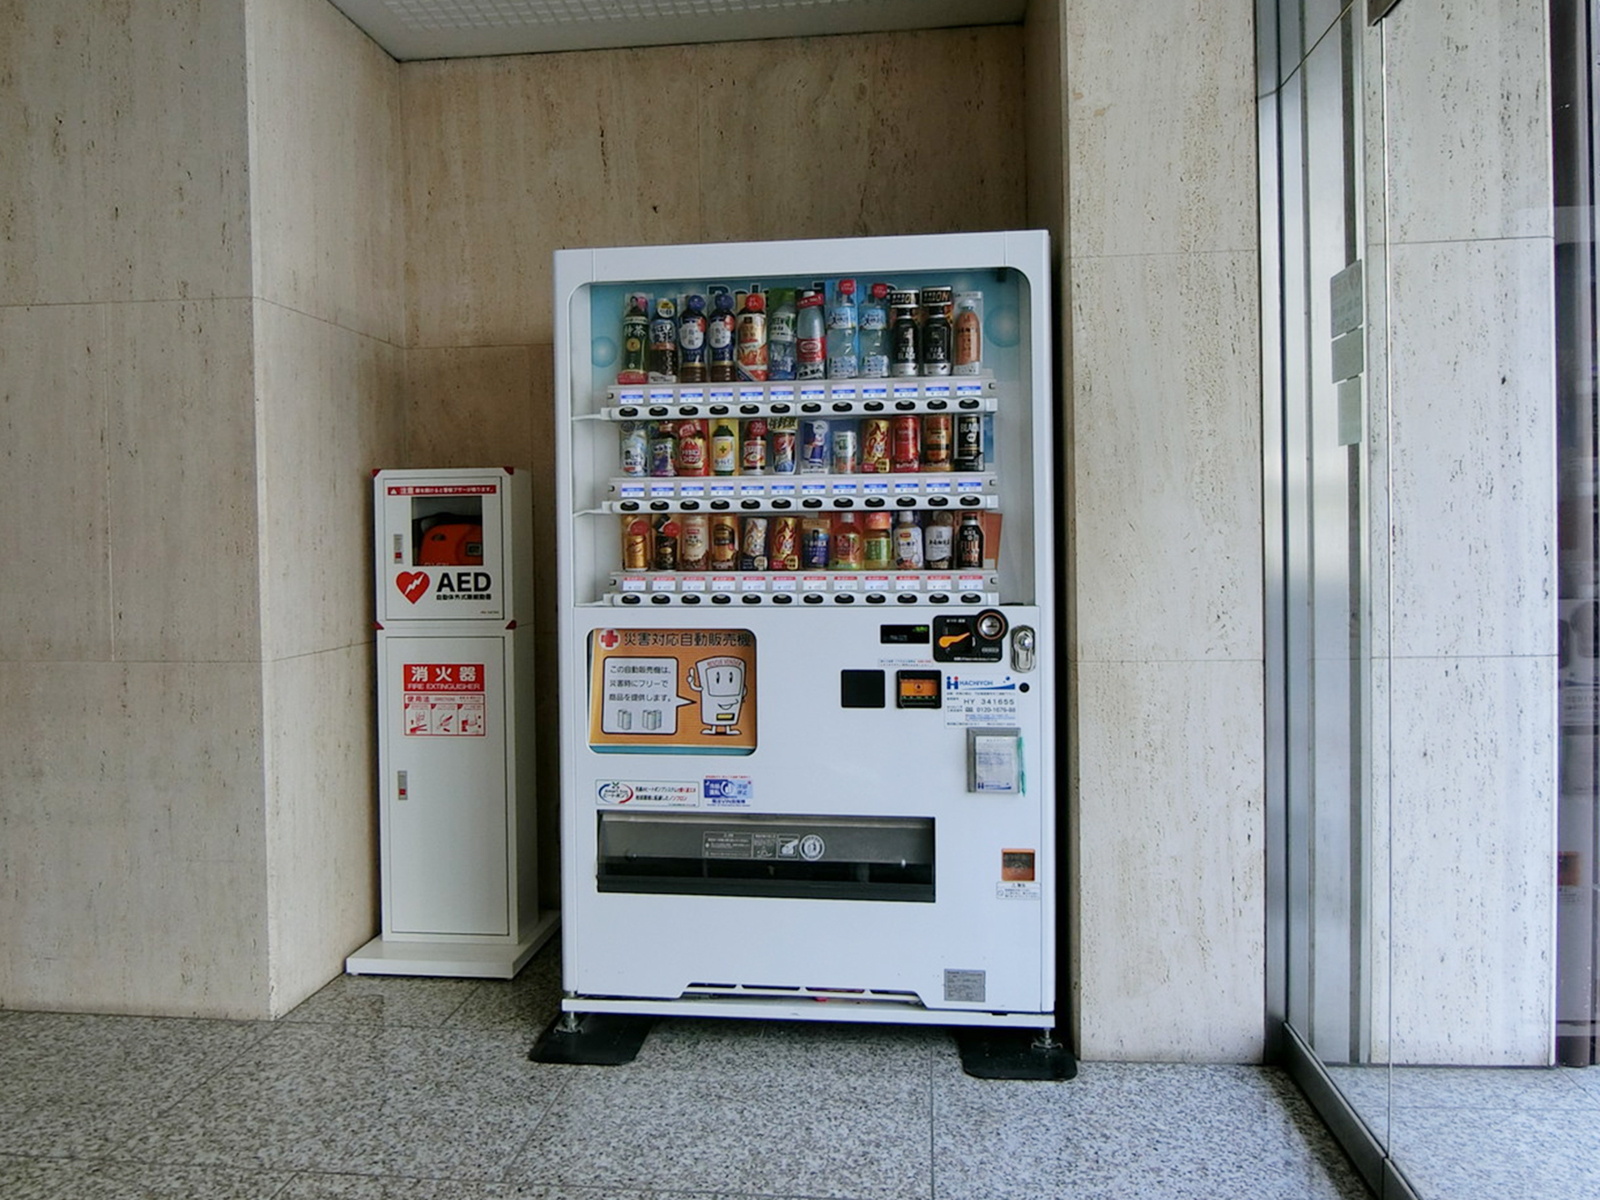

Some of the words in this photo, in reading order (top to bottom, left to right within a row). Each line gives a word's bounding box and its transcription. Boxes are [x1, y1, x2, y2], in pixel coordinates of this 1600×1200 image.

[960, 423, 980, 433] BLACK
[436, 572, 492, 592] AED
[436, 593, 492, 601] 自動体外式除細動器
[624, 631, 752, 647] 災害対応自動販売機
[411, 666, 477, 682] 消火器
[609, 665, 671, 675] この自動販売機は、
[609, 679, 669, 688] 災害時にフリーで
[608, 694, 671, 703] 商品を提供します。
